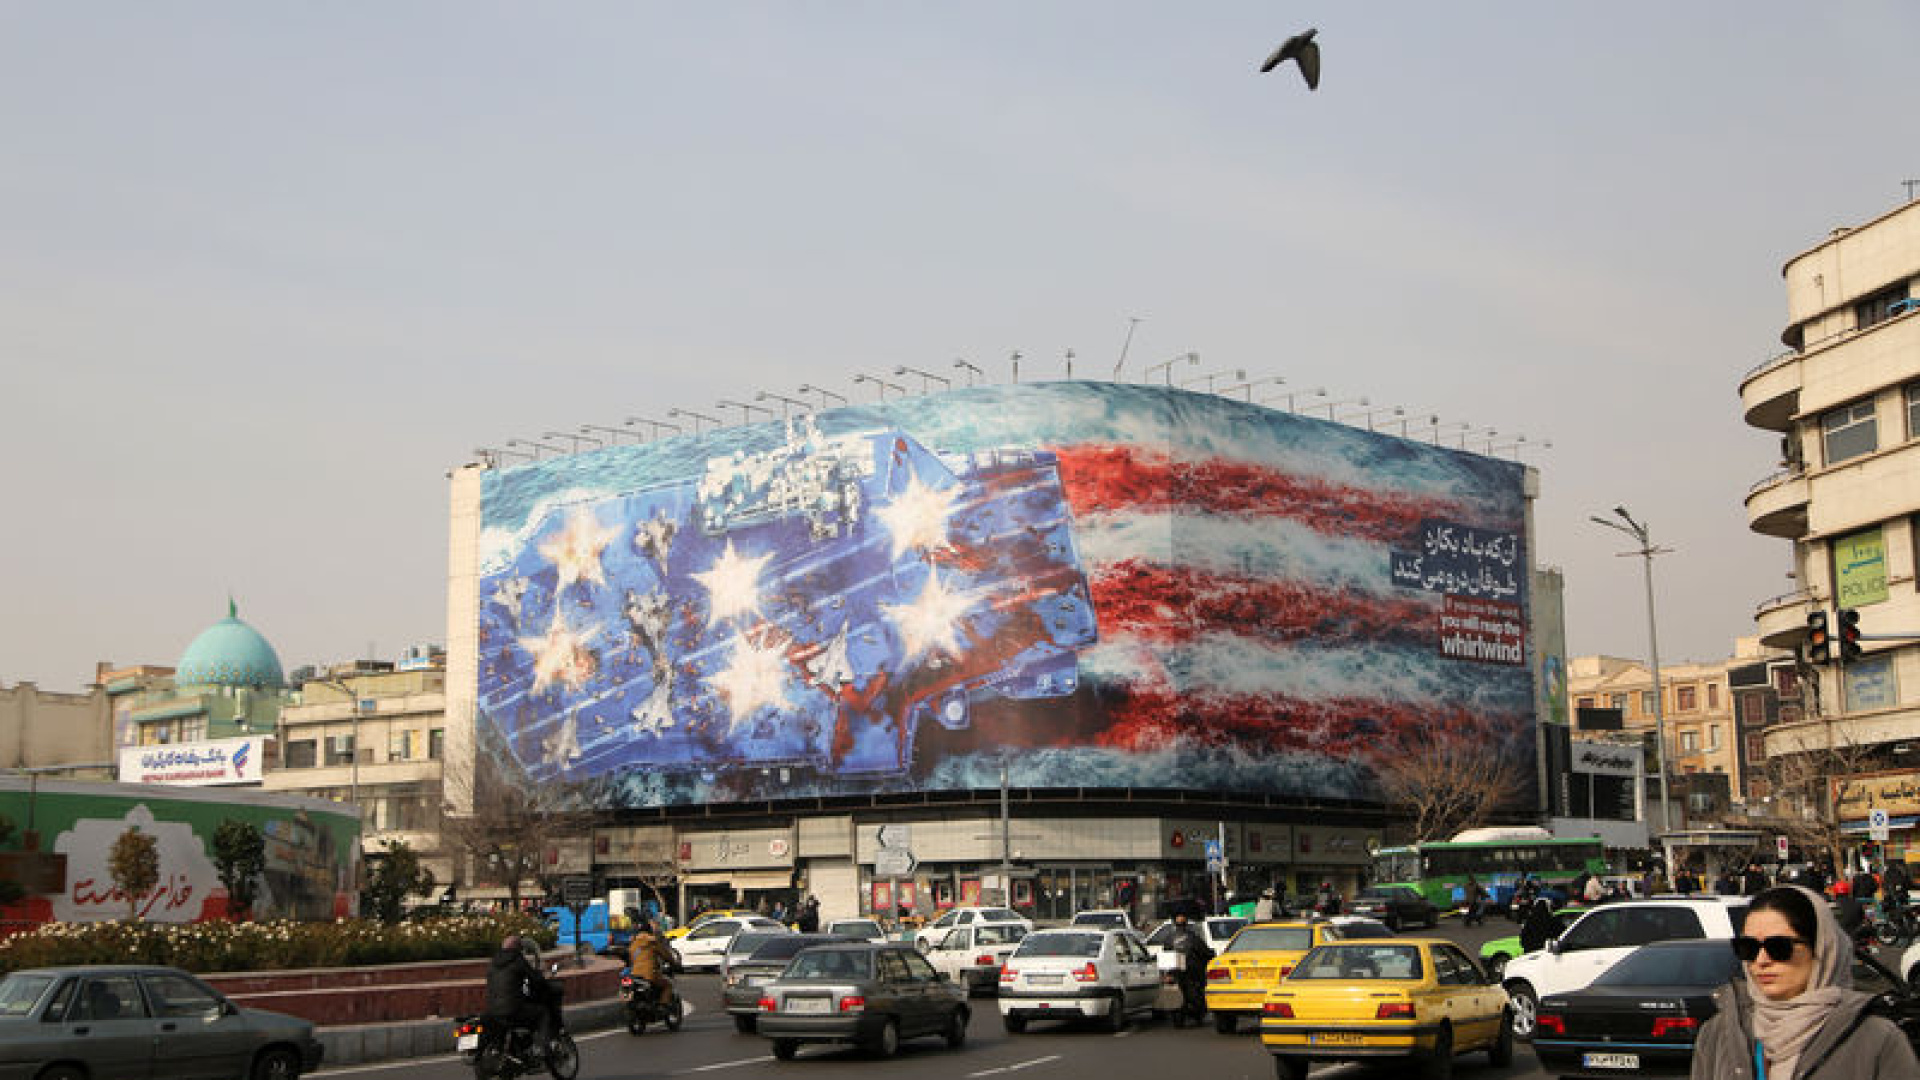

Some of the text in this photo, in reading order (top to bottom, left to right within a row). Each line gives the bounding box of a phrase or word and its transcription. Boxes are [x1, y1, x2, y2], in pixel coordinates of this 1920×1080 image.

[1425, 526, 1460, 557] بکارد
[1843, 576, 1885, 600] POLICE
[1441, 615, 1520, 636] you will reap the
[1442, 632, 1521, 662] whirlwind
